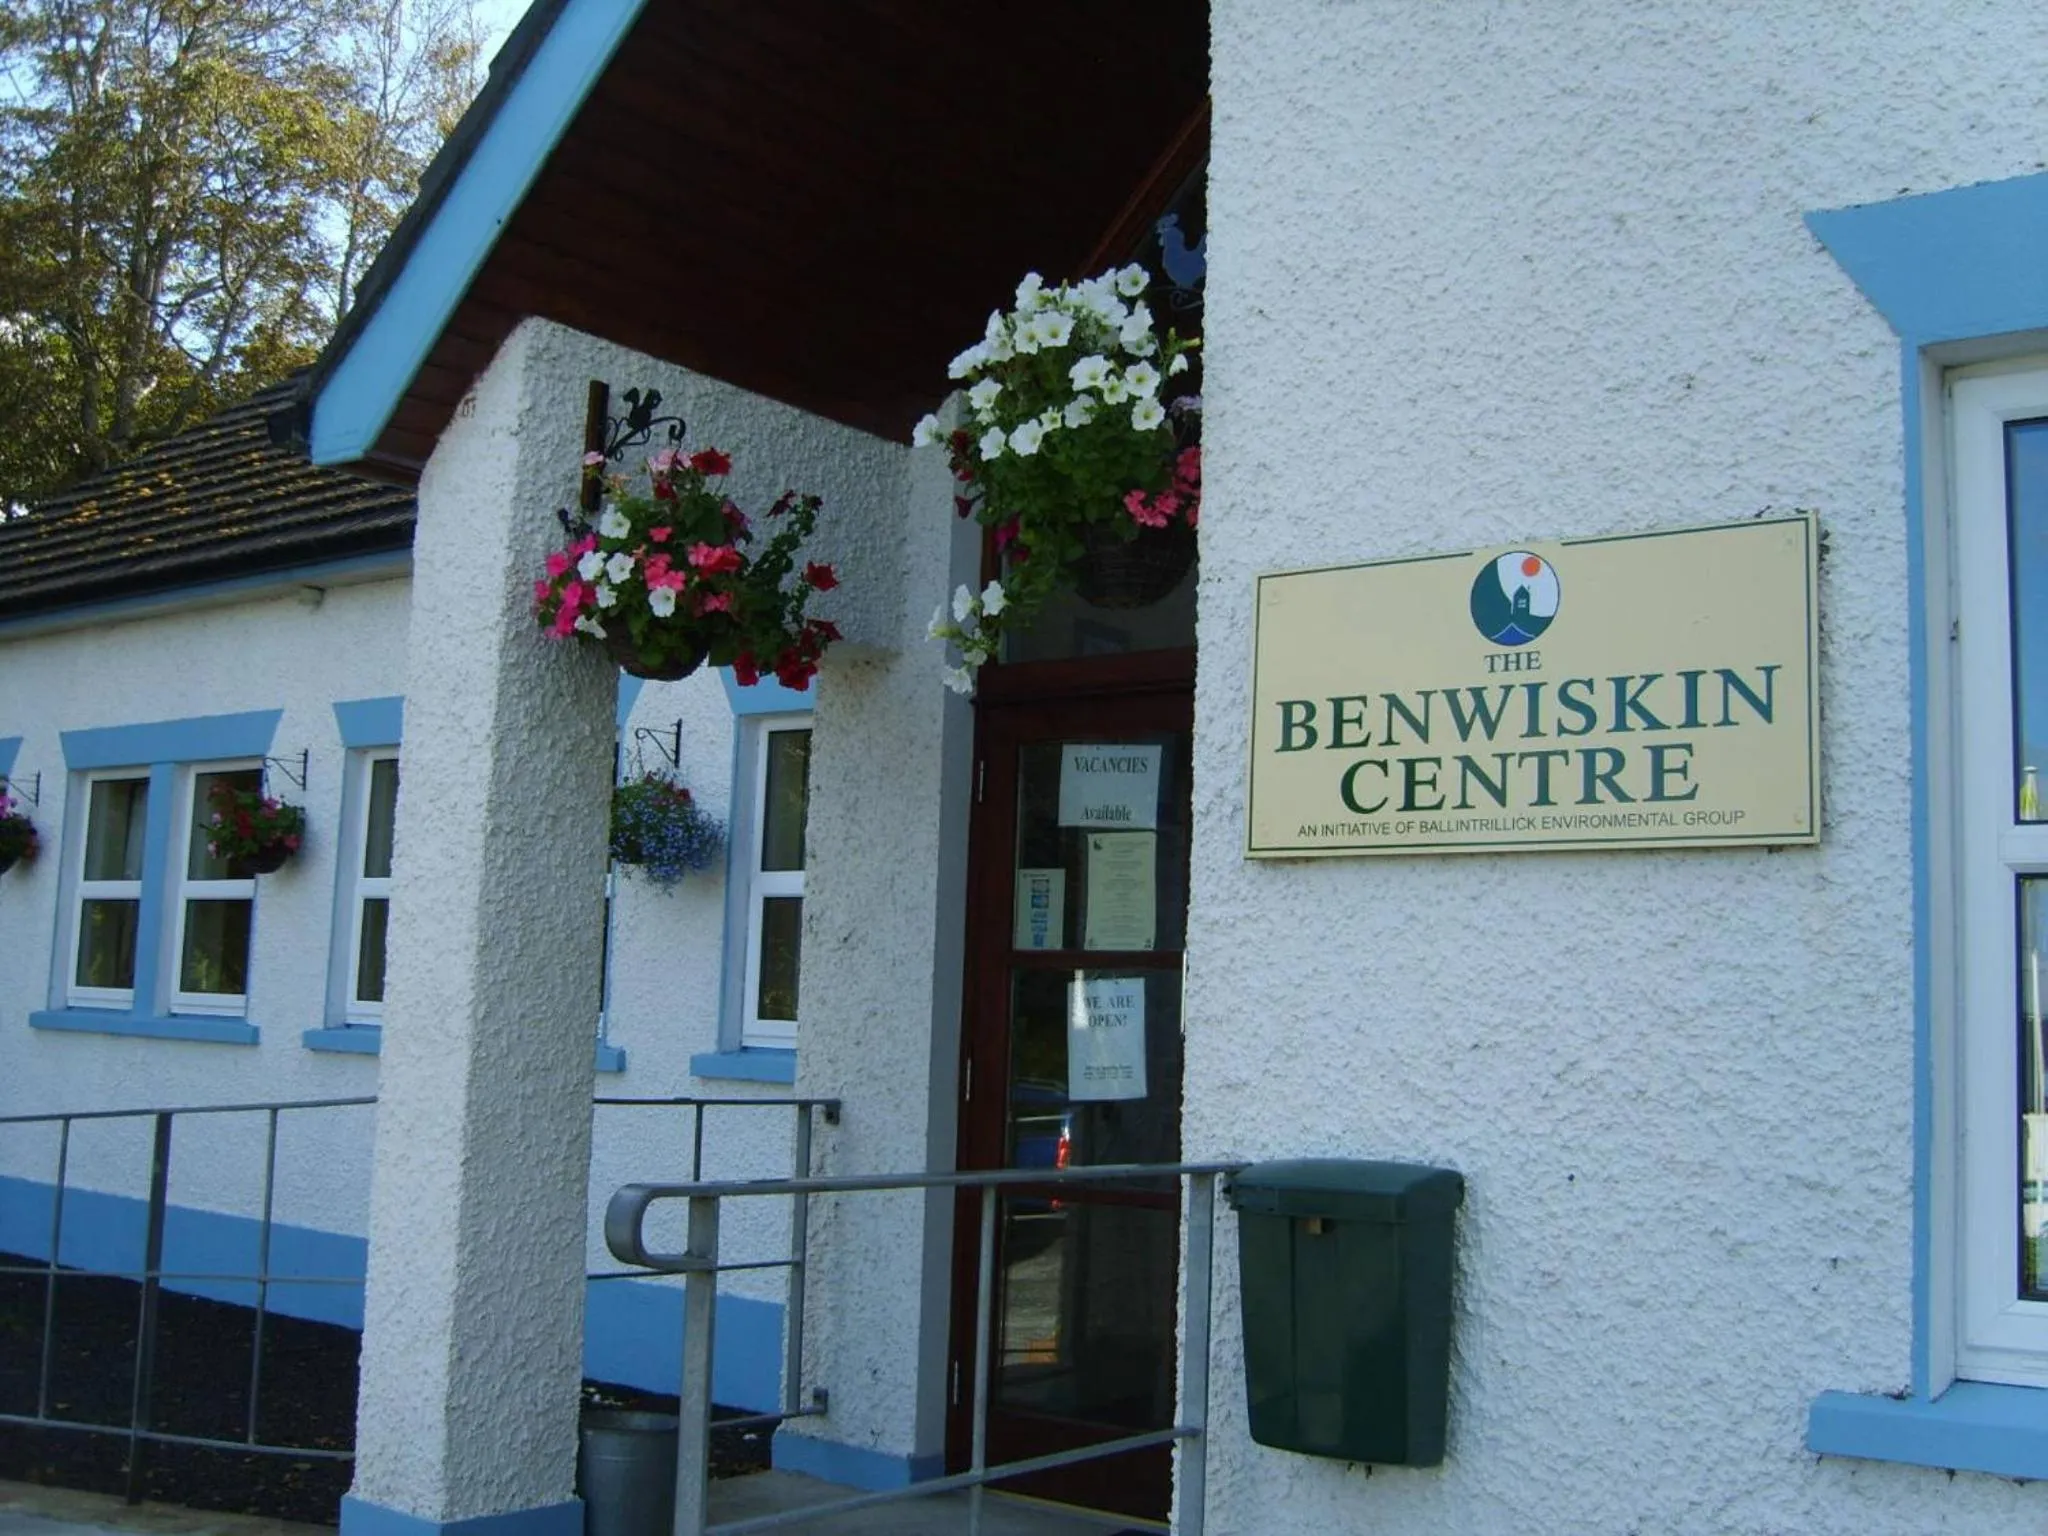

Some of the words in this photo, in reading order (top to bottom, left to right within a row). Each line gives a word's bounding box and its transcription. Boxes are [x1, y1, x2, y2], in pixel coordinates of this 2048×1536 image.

[1484, 650, 1542, 674] THE
[1274, 664, 1783, 753] BENWISKIN
[1073, 756, 1149, 774] VACANCIES
[1340, 741, 1700, 816] CENTRE
[1080, 804, 1132, 821] Available
[1298, 823, 1317, 838] AN
[1321, 821, 1391, 838] INITIATIVE
[1395, 820, 1416, 835] OF
[1419, 816, 1538, 835] BALLINTRILLICK
[1541, 812, 1679, 830] ENVIRONMENTAL
[1683, 810, 1746, 826] GROUP
[1107, 994, 1136, 1009] ARE
